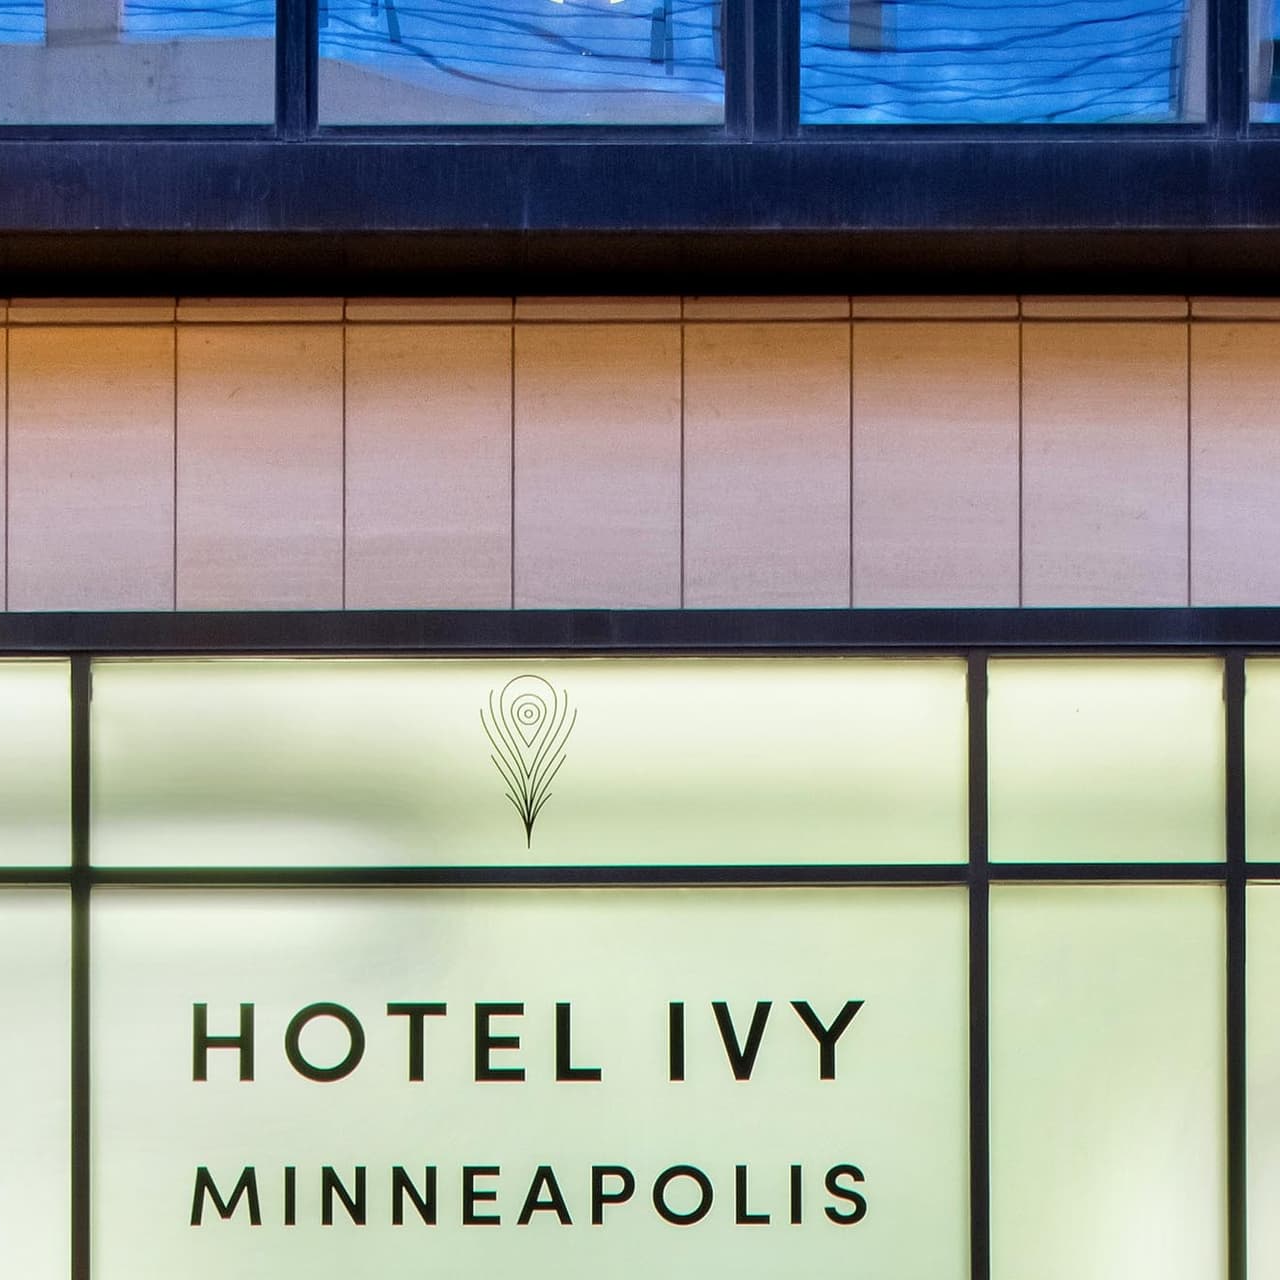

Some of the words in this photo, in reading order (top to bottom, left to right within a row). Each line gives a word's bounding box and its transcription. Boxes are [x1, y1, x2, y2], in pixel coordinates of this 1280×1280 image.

[193, 1002, 602, 1083] HOTEL
[669, 1000, 865, 1081] IVY
[190, 1164, 868, 1227] MINNEAPOLIS
